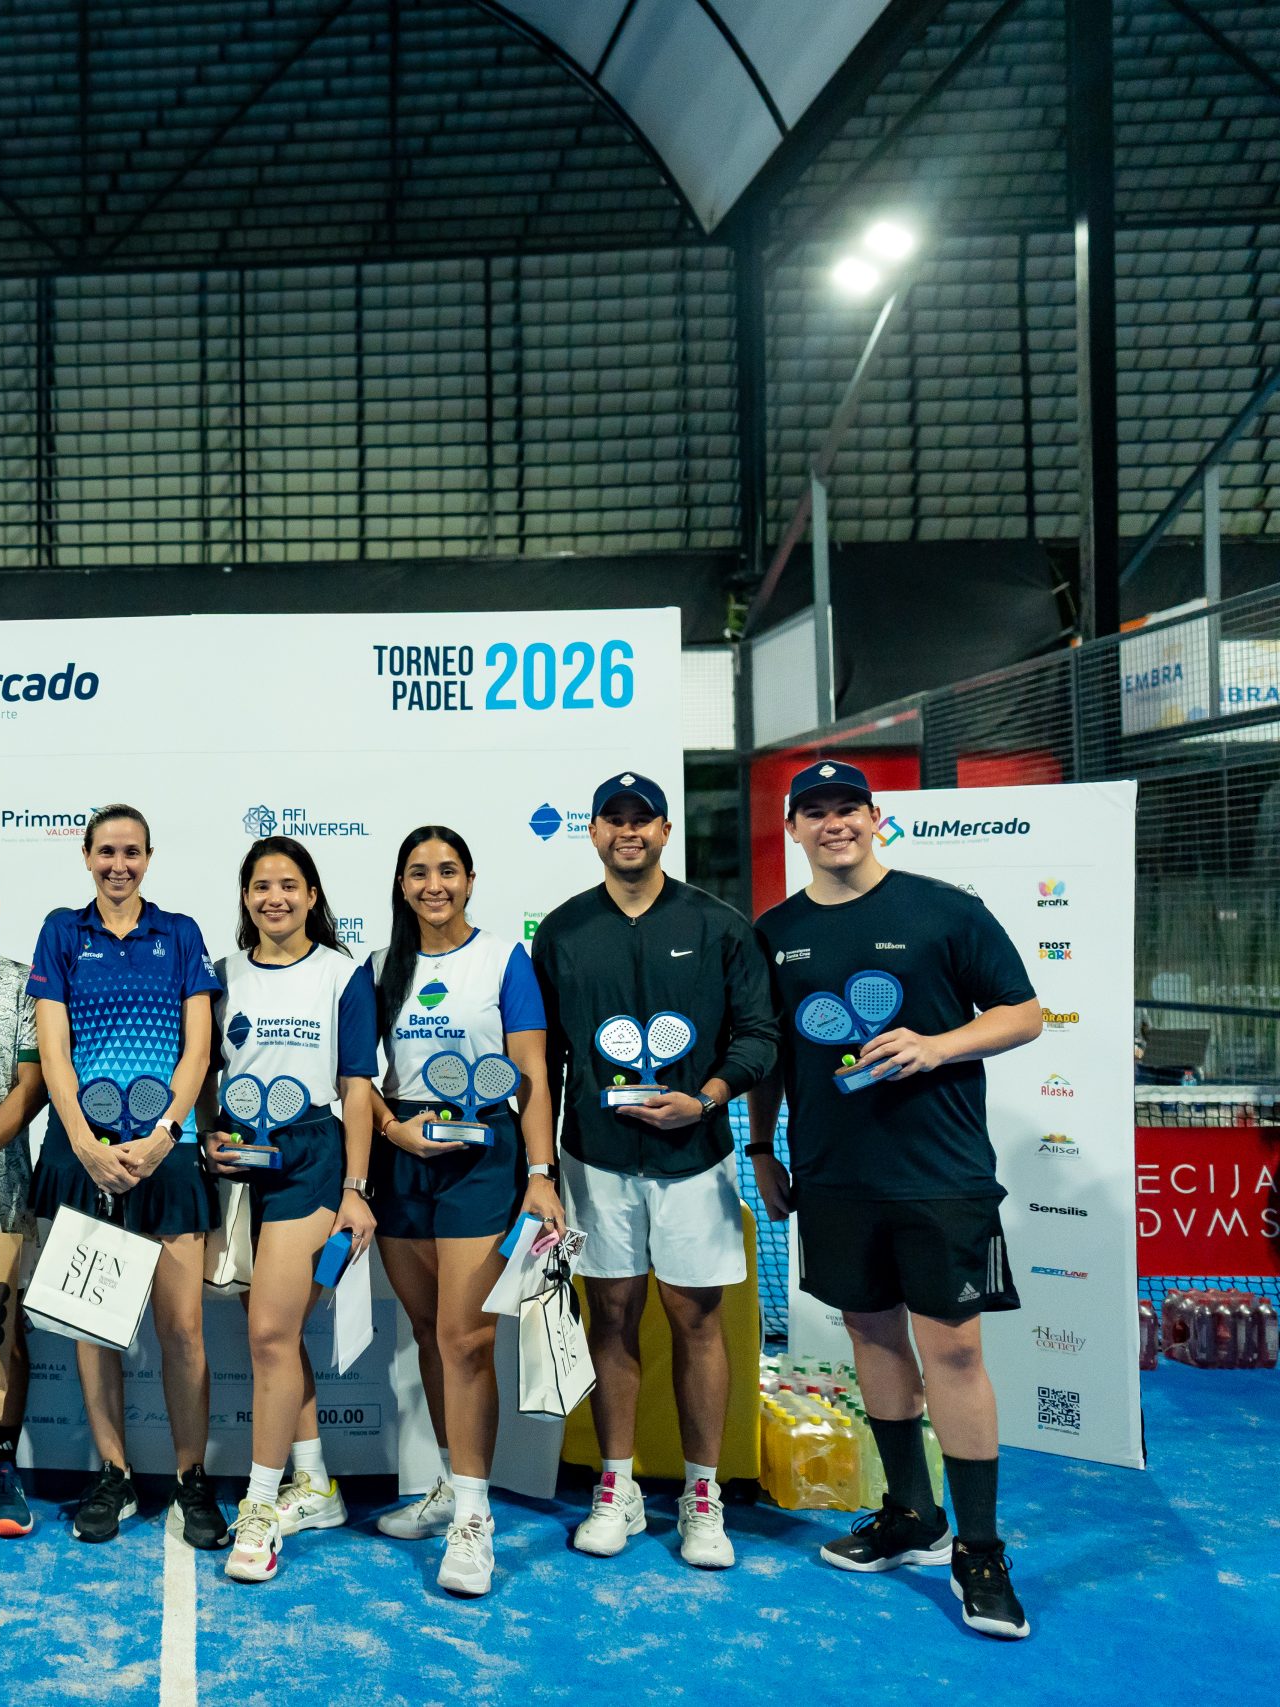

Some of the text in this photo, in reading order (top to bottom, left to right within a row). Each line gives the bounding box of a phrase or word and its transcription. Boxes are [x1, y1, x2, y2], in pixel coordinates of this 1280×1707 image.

[373, 645, 474, 676] TORNEO
[485, 639, 634, 711] 2026
[392, 680, 474, 711] PADEL
[2, 809, 86, 828] Primma
[282, 808, 306, 821] AFI
[45, 828, 86, 836] VALORES
[282, 823, 370, 836] UNIVERSAL
[912, 817, 1031, 838] UnMercado
[1037, 898, 1069, 907] grafix
[875, 942, 906, 950] Wilson
[1039, 942, 1071, 950] FROST
[257, 1016, 321, 1029] Inversiones
[409, 1014, 450, 1026] Banco
[256, 1027, 321, 1041] Santa Cruz
[395, 1026, 466, 1040] Santa Cruz
[1041, 1085, 1074, 1098] Alaska
[1137, 1163, 1278, 1199] ECIJA
[1029, 1202, 1088, 1218] Sensilis
[1138, 1207, 1280, 1238] DVMS
[1035, 1325, 1087, 1351] Healthy
[137, 1370, 153, 1379] del
